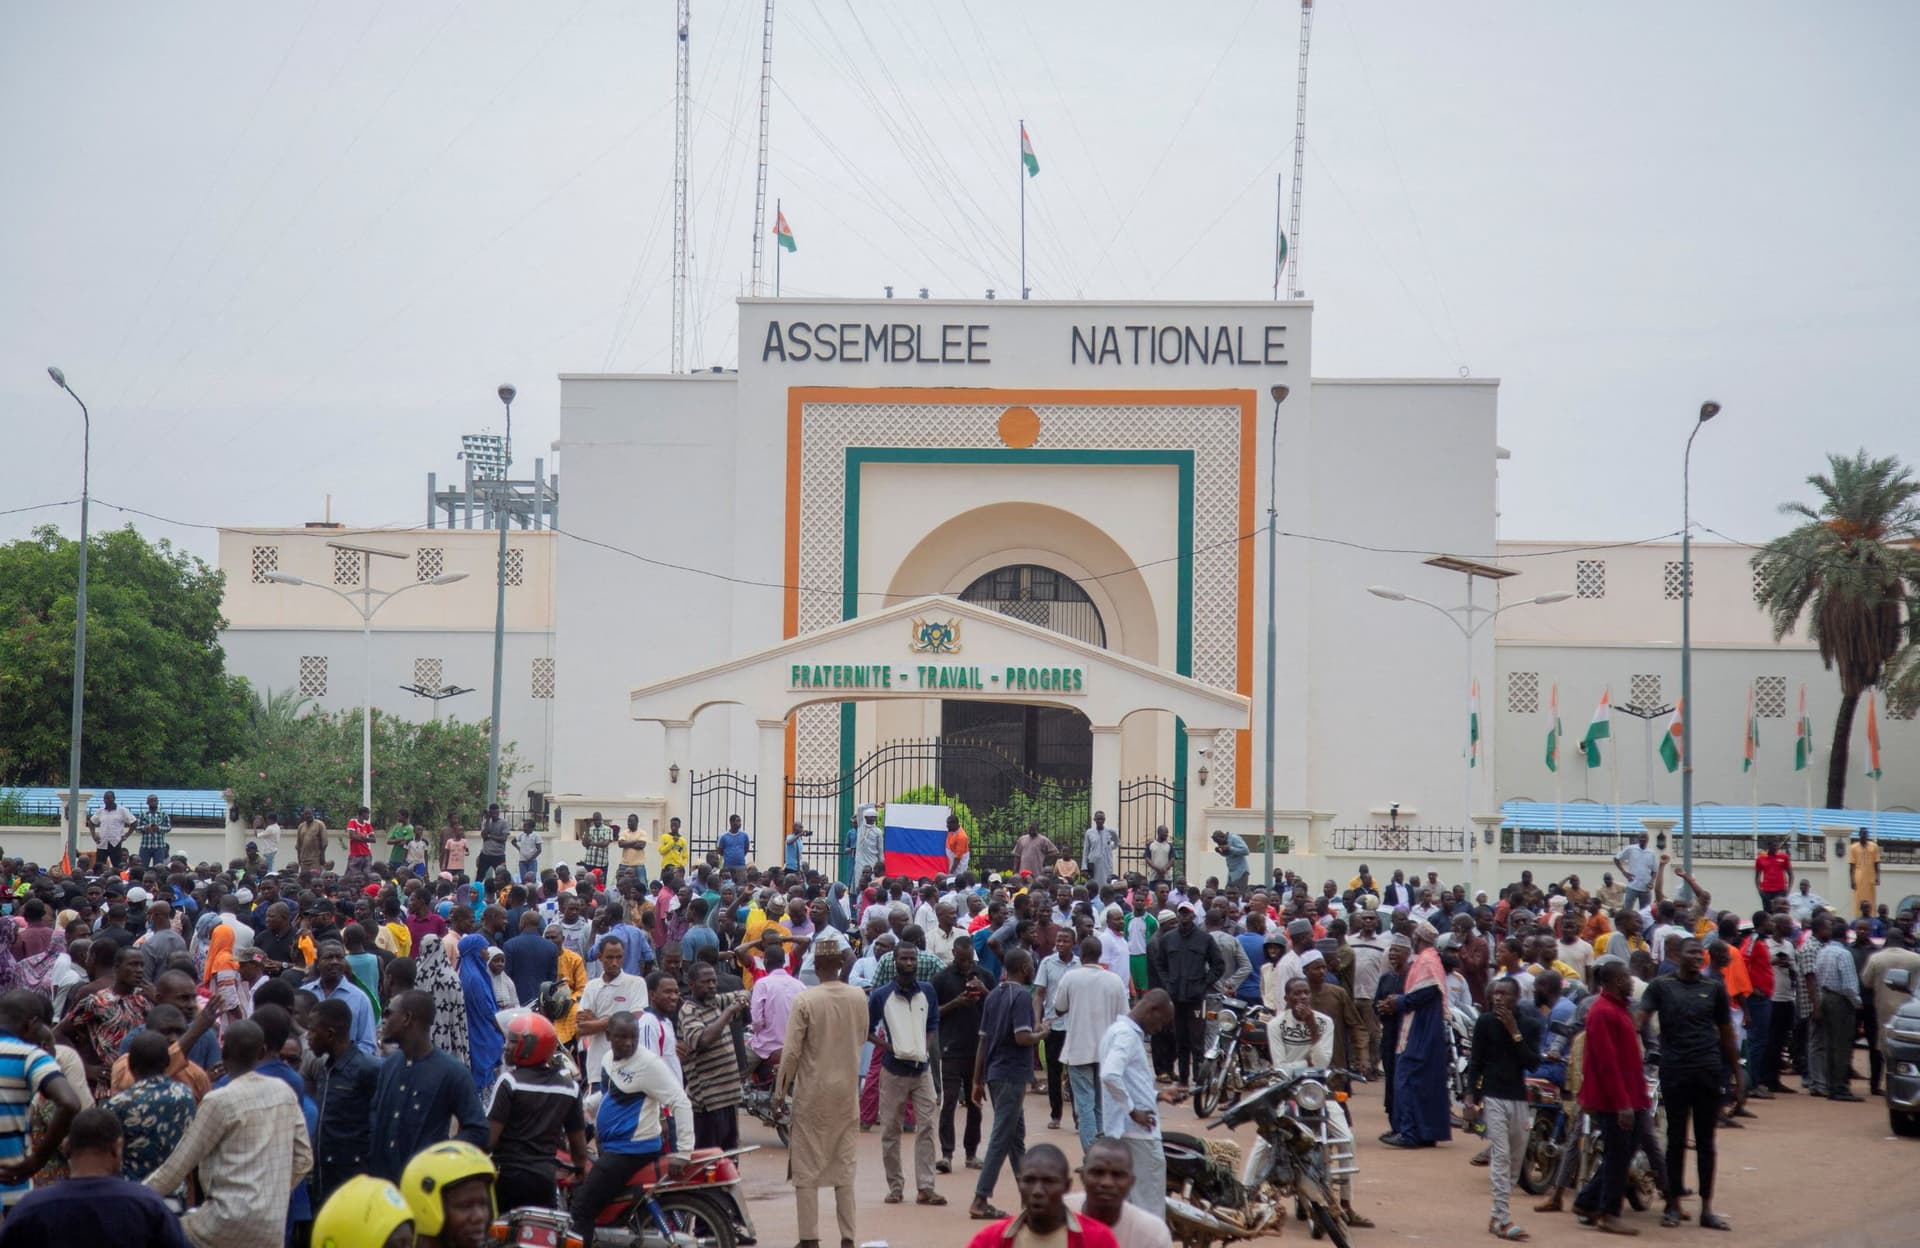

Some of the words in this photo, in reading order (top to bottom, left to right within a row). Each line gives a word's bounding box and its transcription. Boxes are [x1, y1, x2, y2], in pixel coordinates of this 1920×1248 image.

[762, 320, 991, 364] ASSEMBLEE
[1071, 325, 1288, 365] NATIONALE
[791, 665, 891, 687] FRATERNITE
[917, 666, 983, 689] TRAVAIL
[1006, 667, 1082, 690] PROGRES
